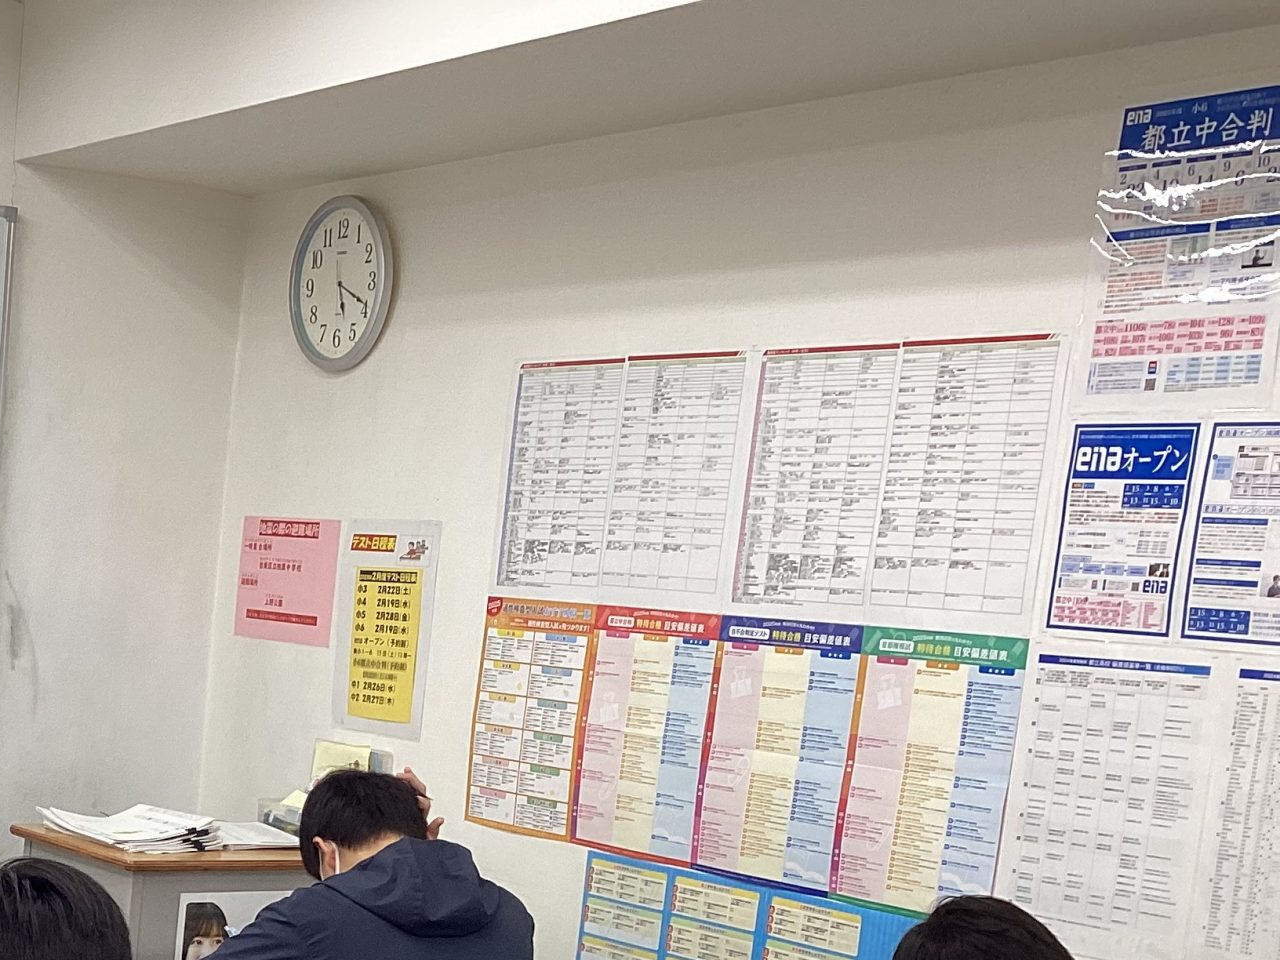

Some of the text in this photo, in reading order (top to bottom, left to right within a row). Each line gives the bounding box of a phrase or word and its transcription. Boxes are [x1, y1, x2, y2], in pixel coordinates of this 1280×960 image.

[1126, 109, 1152, 126] ena
[1141, 108, 1273, 151] 都立中合判
[323, 228, 332, 248] 11
[337, 218, 349, 239] 12
[356, 224, 361, 243] 1
[311, 249, 322, 269] 10
[365, 243, 372, 263] 2
[306, 279, 314, 297] 9
[368, 271, 376, 291] 3
[310, 305, 317, 324] 8
[361, 300, 368, 318] 4
[319, 324, 327, 342] 7
[332, 328, 340, 348] 6
[348, 323, 356, 341] 5
[1076, 445, 1188, 473] enaオープン
[1142, 579, 1168, 594] ena
